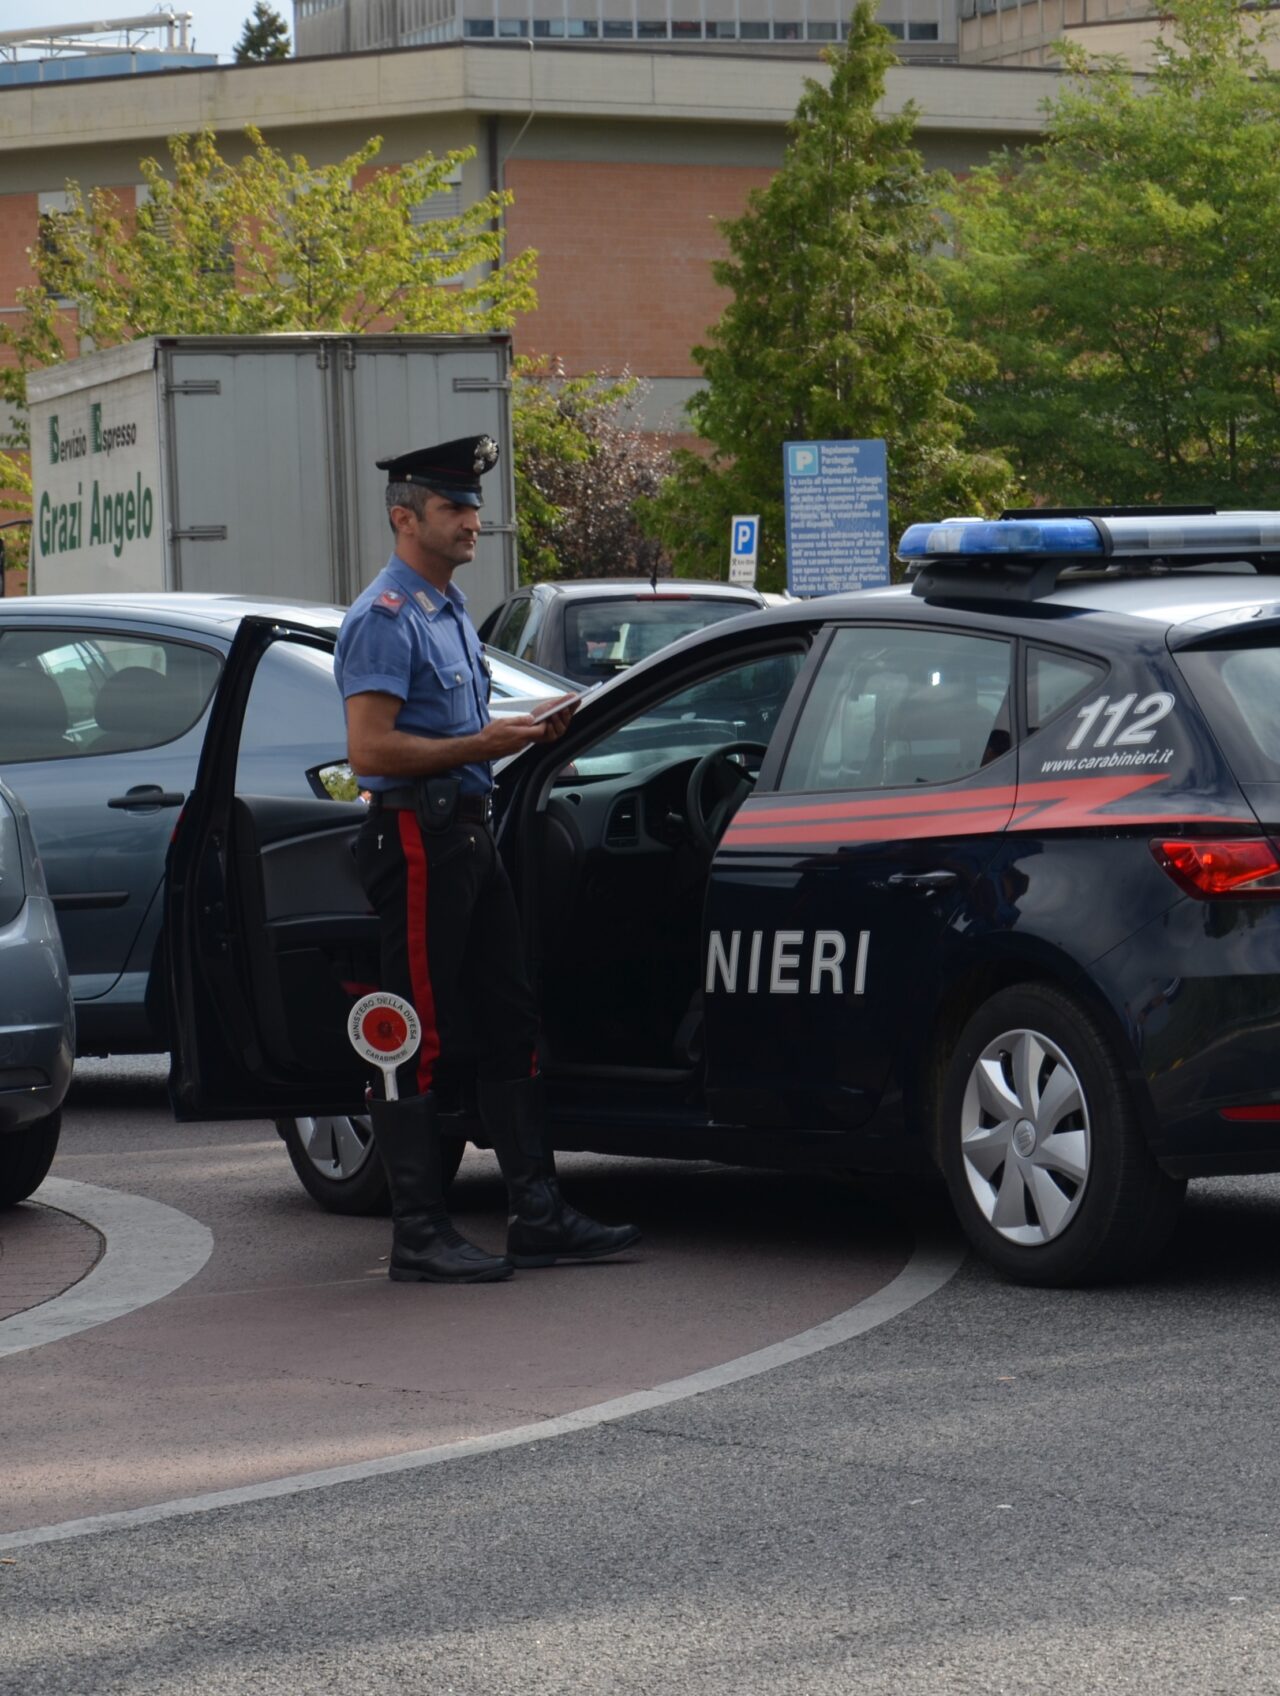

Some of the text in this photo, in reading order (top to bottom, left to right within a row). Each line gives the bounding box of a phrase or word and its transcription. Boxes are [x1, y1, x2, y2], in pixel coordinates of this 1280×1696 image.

[49, 402, 137, 465] Servizio Espresso
[796, 450, 813, 471] P
[39, 471, 153, 557] Grazi Angelo
[737, 525, 751, 551] P
[1066, 692, 1176, 750] 112
[1041, 749, 1175, 773] www.carabinieri.it
[705, 930, 871, 994] NIERI
[353, 997, 417, 1041] MINISTERO DELLA DIFESA
[366, 1049, 408, 1062] CARABINIERI
